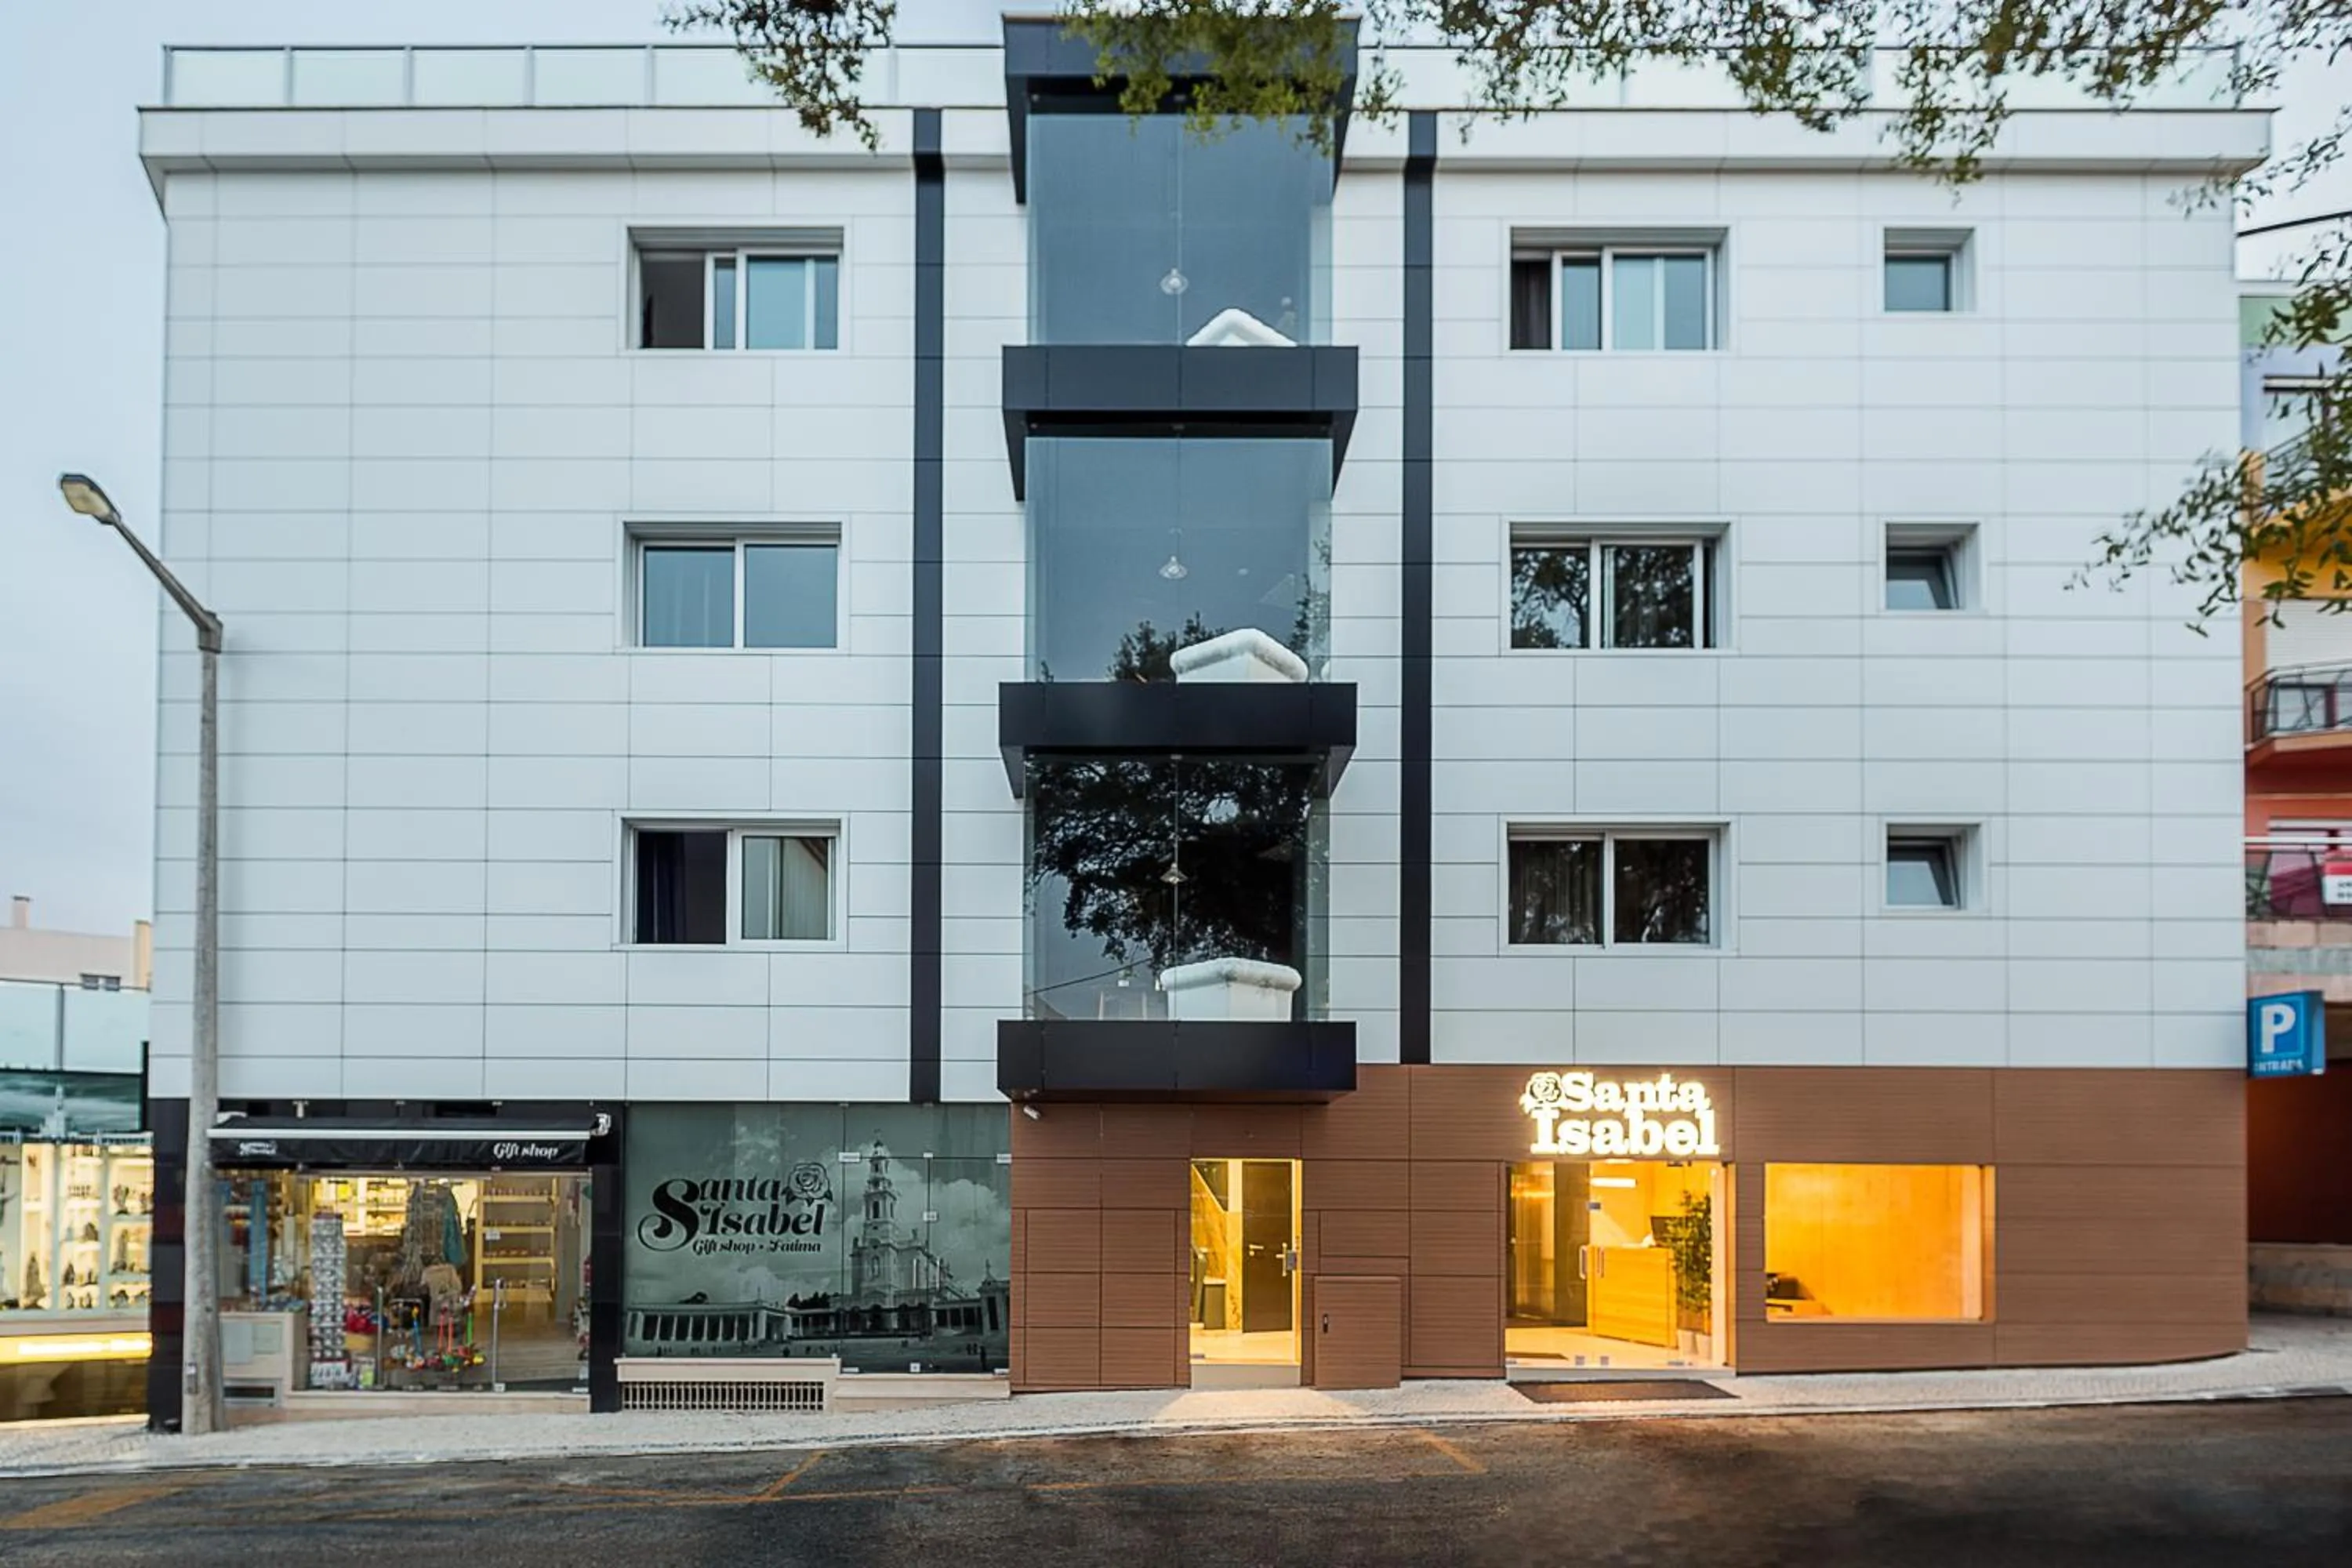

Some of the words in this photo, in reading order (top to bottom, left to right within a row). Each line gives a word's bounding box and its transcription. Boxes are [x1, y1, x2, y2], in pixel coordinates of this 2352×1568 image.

[2261, 1004, 2296, 1053] P
[1560, 1072, 1710, 1112] Santa
[493, 1142, 519, 1159] Gift
[521, 1142, 559, 1160] shop
[1530, 1108, 1719, 1155] Isabel
[637, 1178, 781, 1252] Santa
[699, 1202, 826, 1236] Isabel
[692, 1239, 717, 1254] Gift
[720, 1239, 757, 1254] shop
[769, 1239, 822, 1253] Fatima
